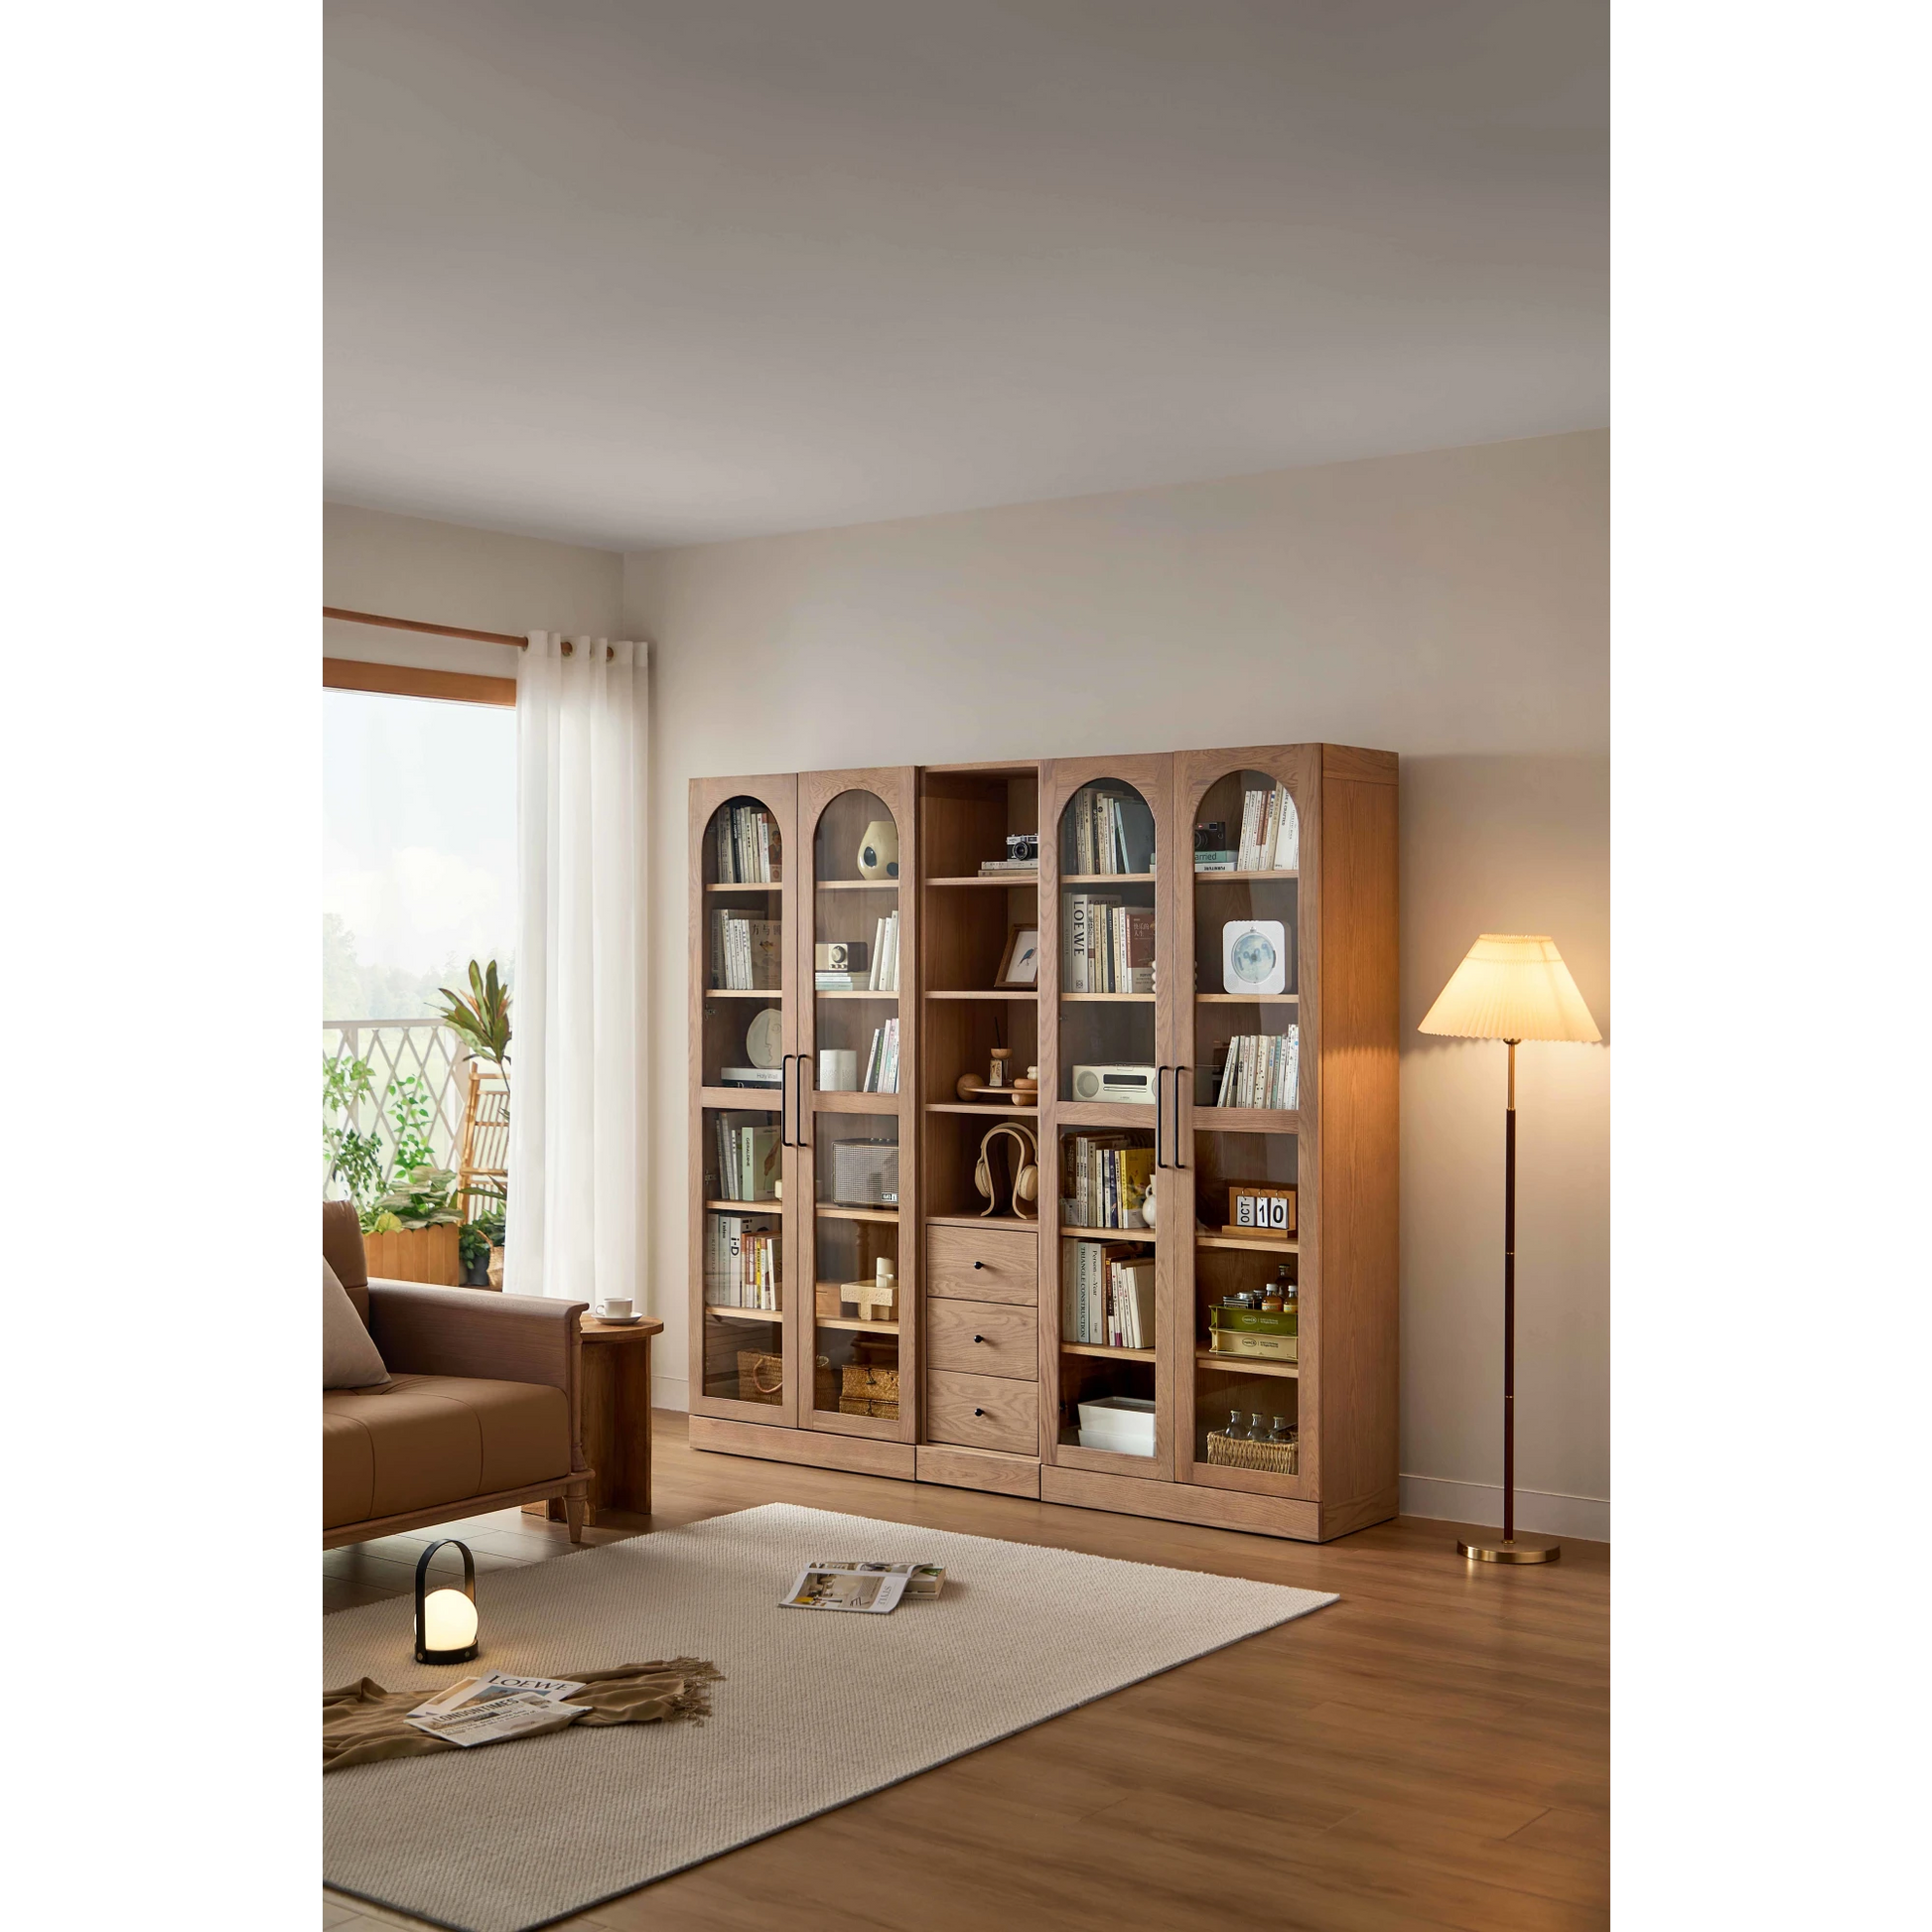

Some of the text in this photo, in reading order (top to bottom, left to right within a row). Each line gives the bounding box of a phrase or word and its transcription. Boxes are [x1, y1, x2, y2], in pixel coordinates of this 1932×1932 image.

[1073, 900, 1085, 957] LOEWE
[1240, 1201, 1251, 1223] OCT
[731, 1237, 740, 1256] i-D
[487, 1675, 574, 1692] LOEWE
